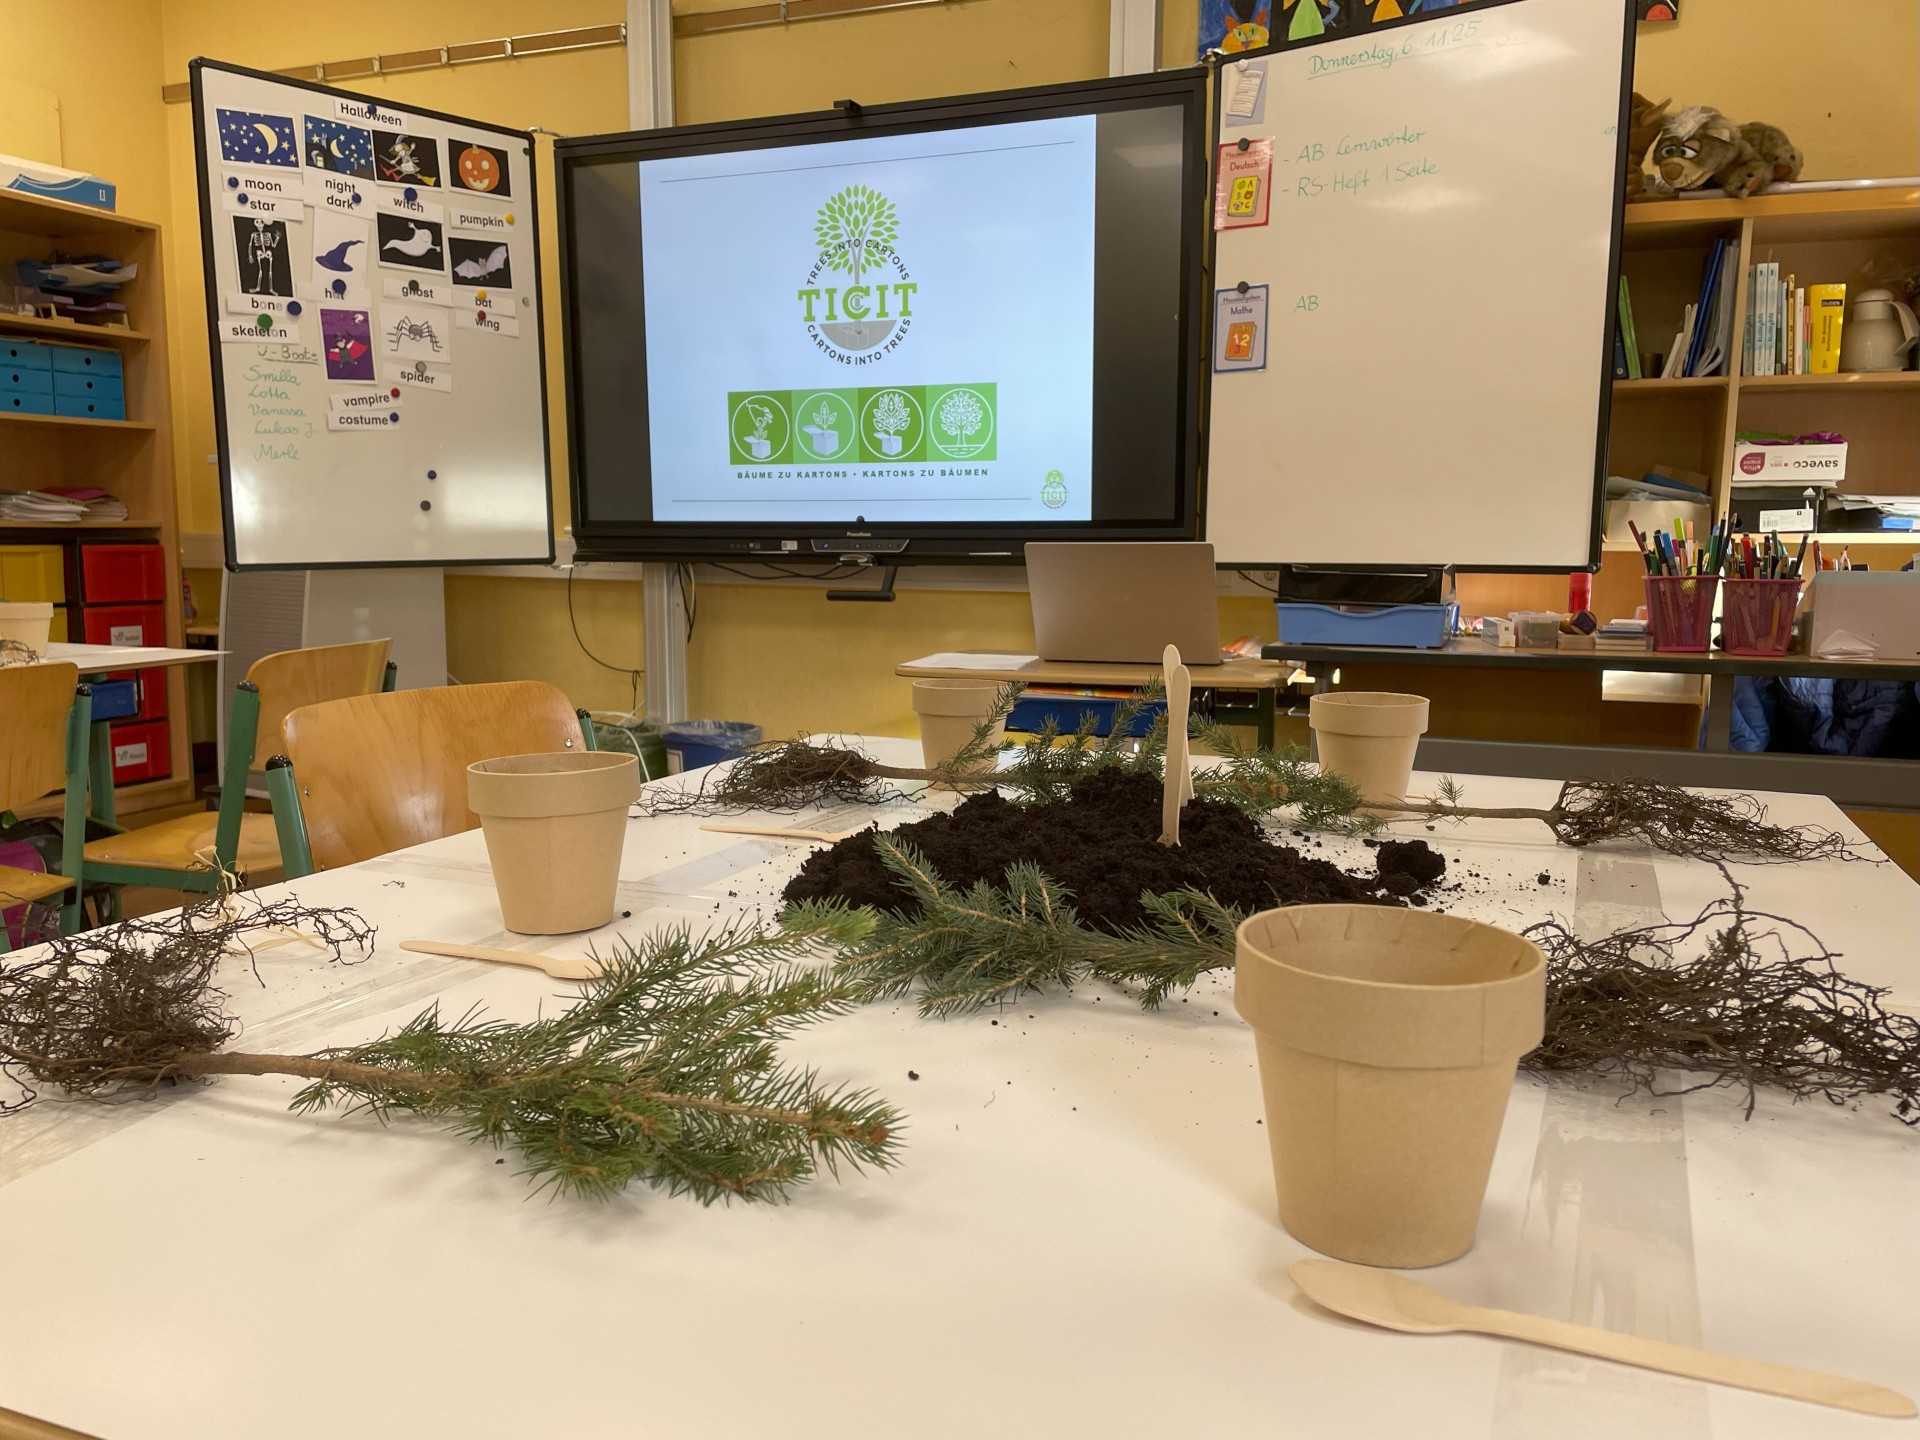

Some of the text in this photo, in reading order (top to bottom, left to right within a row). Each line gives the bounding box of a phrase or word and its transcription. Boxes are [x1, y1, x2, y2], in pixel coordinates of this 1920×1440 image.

[1309, 42, 1399, 75] Donnerstag,
[340, 102, 402, 127] Halloween
[1230, 160, 1259, 171] Deutsch
[1395, 156, 1441, 182] Seite
[244, 179, 282, 192] moon
[325, 178, 356, 194] night
[250, 200, 276, 212] star
[326, 194, 355, 211] dark
[393, 196, 424, 213] witch
[459, 214, 504, 228] pumpkin
[807, 238, 910, 286] TREES INTO CARTONS
[401, 284, 434, 299] ghost
[251, 298, 283, 312] bone
[475, 296, 492, 309] bat
[798, 283, 918, 322] TICIT
[1293, 295, 1319, 313] AB
[1230, 305, 1253, 316] Mathe
[232, 325, 287, 338] skeleton
[475, 317, 500, 332] wing
[807, 318, 911, 366] CARTONS INTO TREES
[242, 364, 302, 386] Smilla
[400, 369, 435, 384] spider
[248, 385, 291, 400] Lotta
[343, 393, 390, 407] vampire
[248, 403, 307, 418] Vanessa
[339, 415, 389, 426] costume
[1793, 459, 1839, 468] saveco
[737, 467, 989, 479] BÄUME ZU KARTONS KARTONS ZU BÄUMEN
[1040, 491, 1068, 500] TICIT
